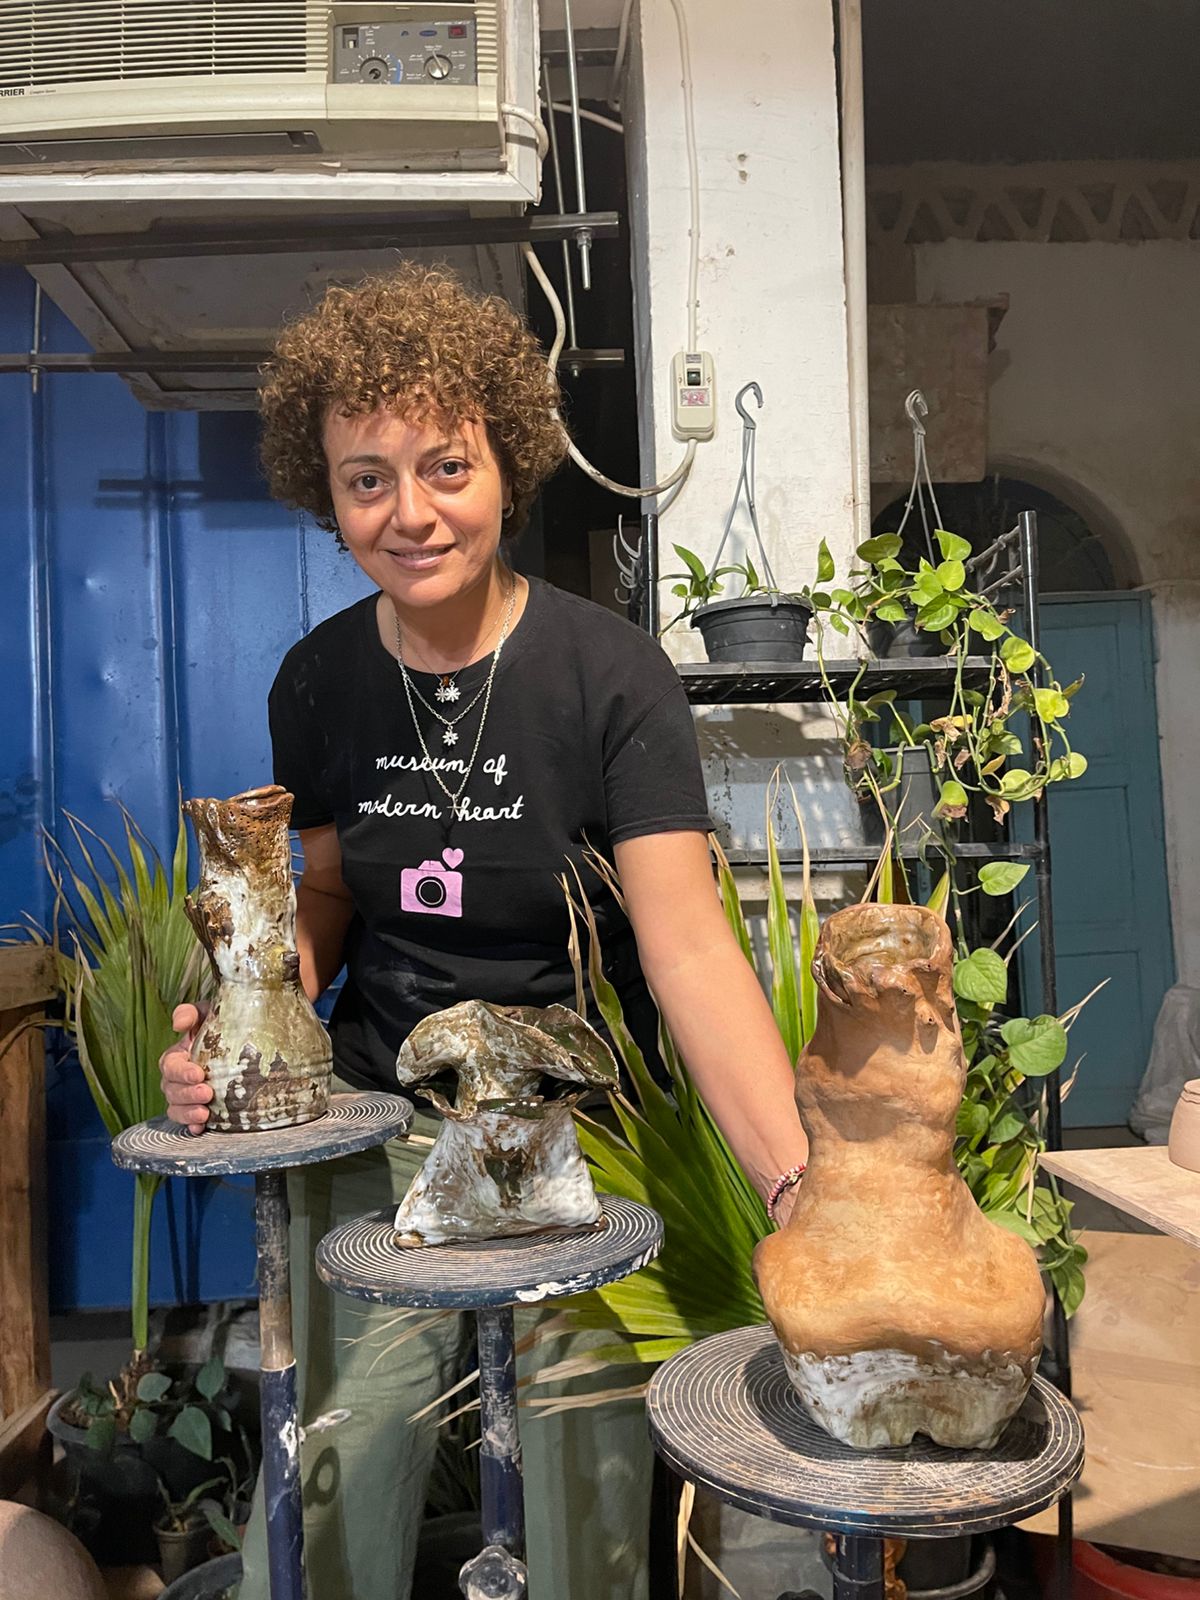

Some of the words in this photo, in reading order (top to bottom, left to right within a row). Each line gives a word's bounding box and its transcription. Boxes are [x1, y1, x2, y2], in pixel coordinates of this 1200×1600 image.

[375, 755, 469, 774] museum
[483, 754, 508, 785] of
[358, 794, 442, 819] modern
[457, 795, 525, 822] heart
